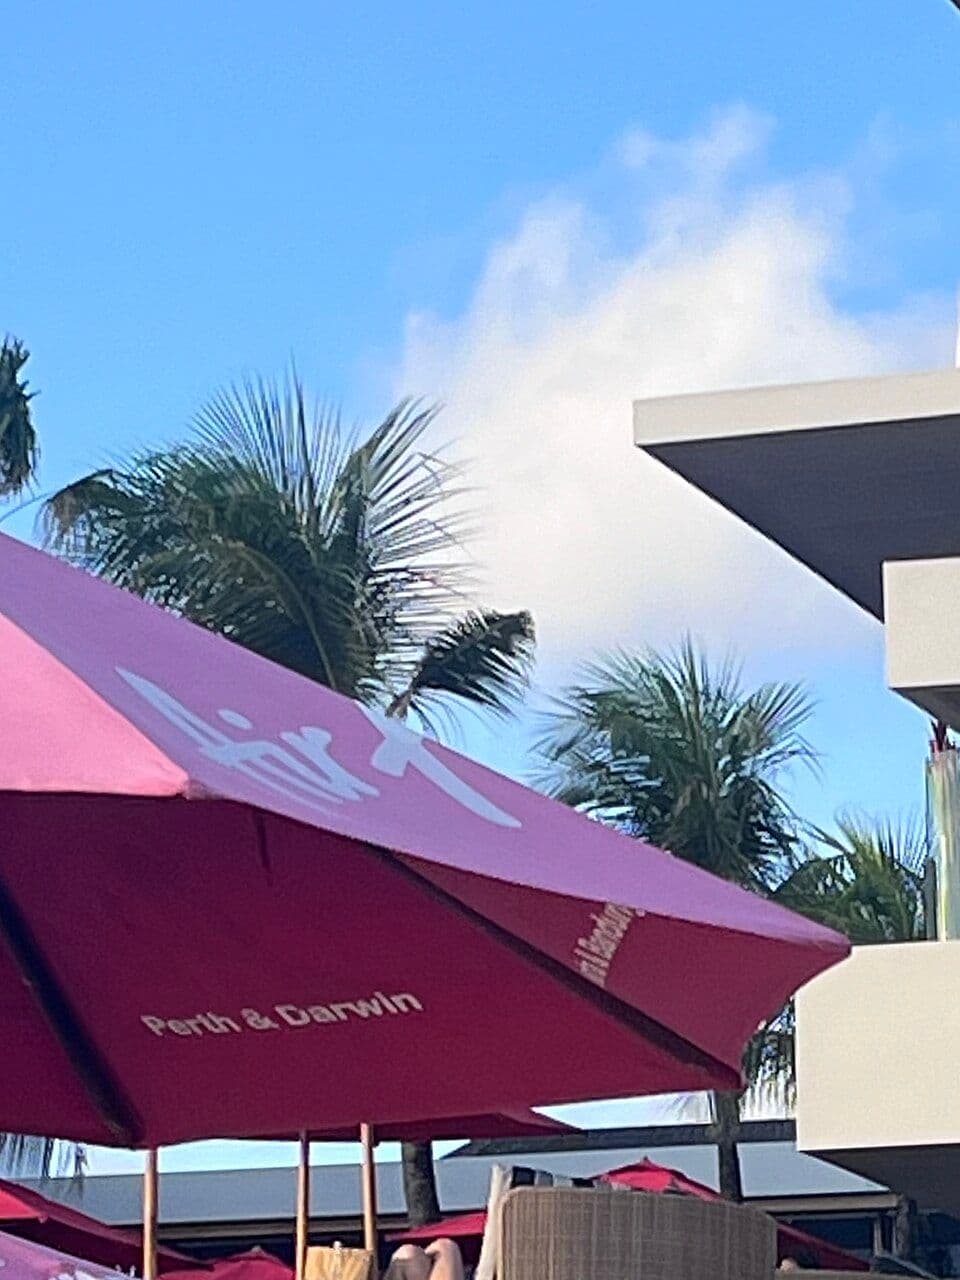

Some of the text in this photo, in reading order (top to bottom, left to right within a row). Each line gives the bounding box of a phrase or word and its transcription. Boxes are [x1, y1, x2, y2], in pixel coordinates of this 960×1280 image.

[140, 991, 424, 1036] Perth & Darwin
